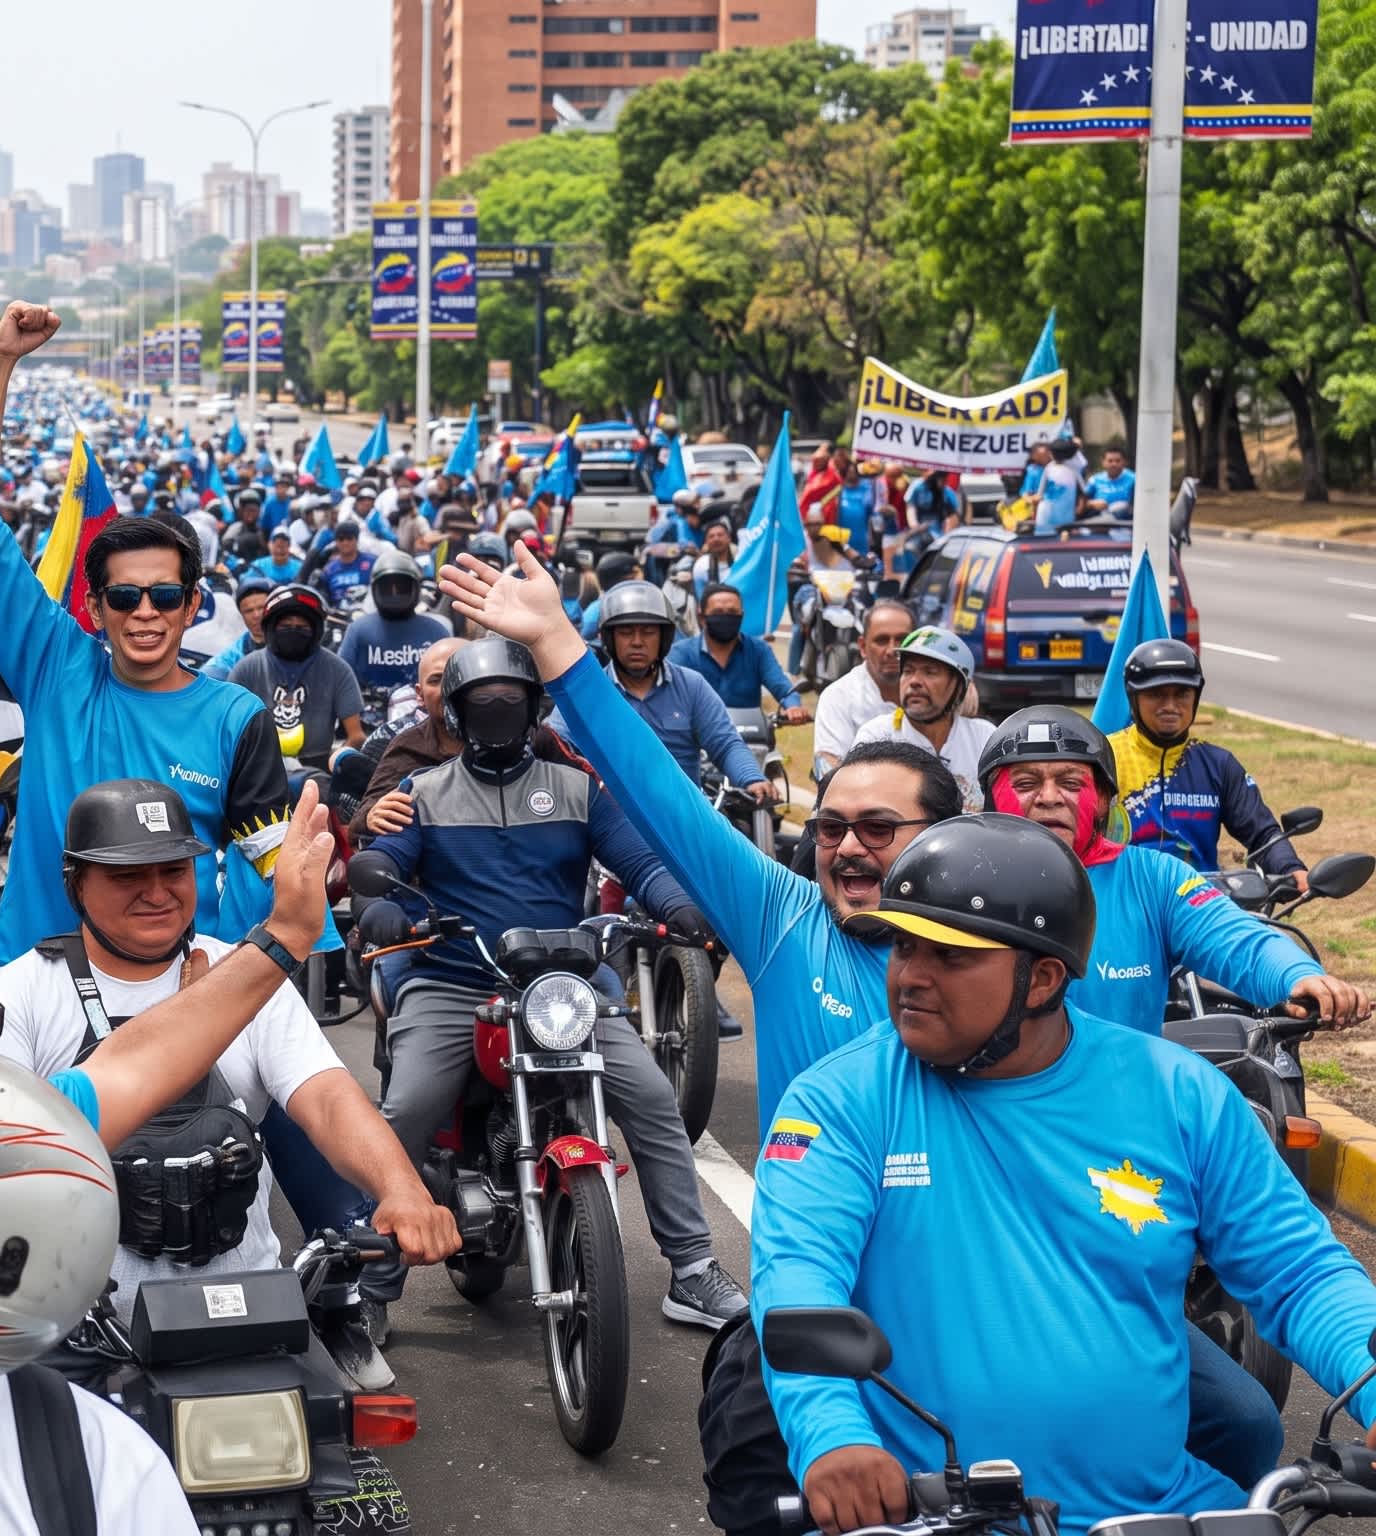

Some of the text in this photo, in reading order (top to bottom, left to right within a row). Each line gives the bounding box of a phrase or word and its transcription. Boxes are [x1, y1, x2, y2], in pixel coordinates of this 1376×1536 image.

[1020, 23, 1149, 60] ¡LIBERTAD!
[1210, 20, 1308, 53] UNIDAD
[859, 416, 903, 444] POR
